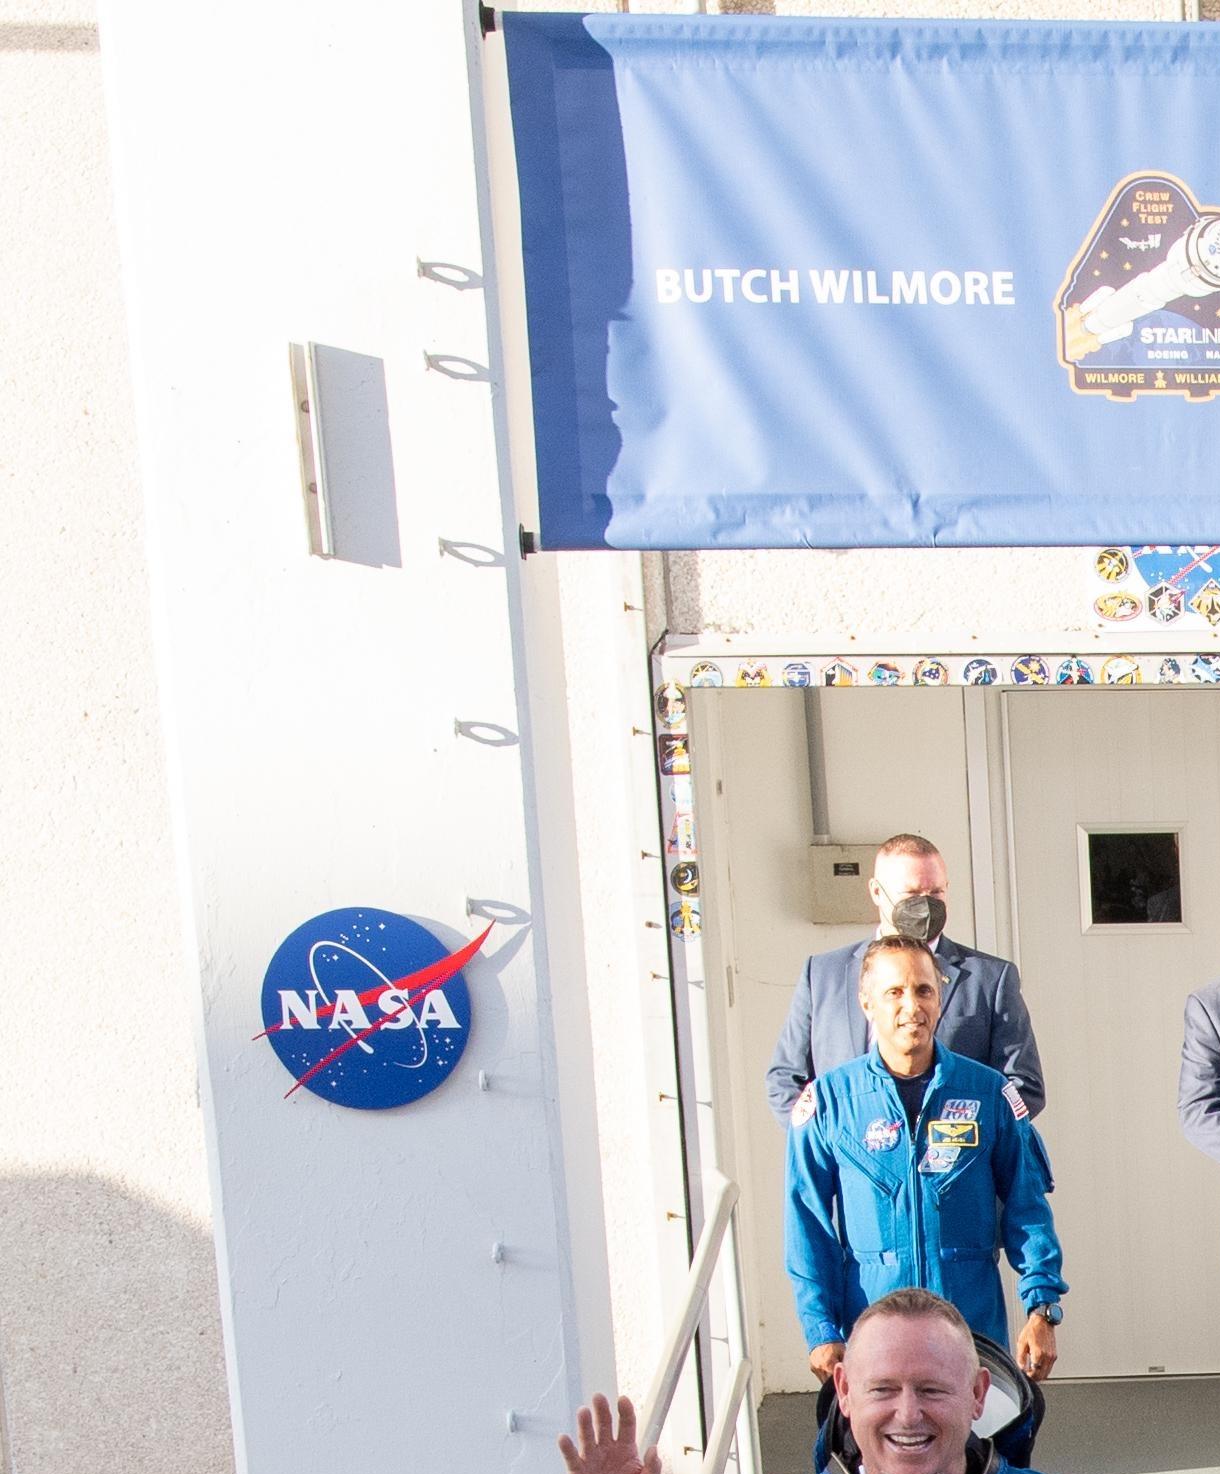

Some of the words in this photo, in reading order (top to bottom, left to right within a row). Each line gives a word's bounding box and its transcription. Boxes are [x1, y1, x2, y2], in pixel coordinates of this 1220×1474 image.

[1135, 191, 1170, 201] CREW
[1132, 201, 1174, 213] FLIGHT
[1138, 213, 1168, 224] TEST
[655, 268, 800, 304] BUTCH
[808, 269, 1016, 306] WILMORE
[1147, 350, 1189, 360] BOEING
[1084, 373, 1145, 384] WILMORE
[276, 988, 462, 1031] NASA
